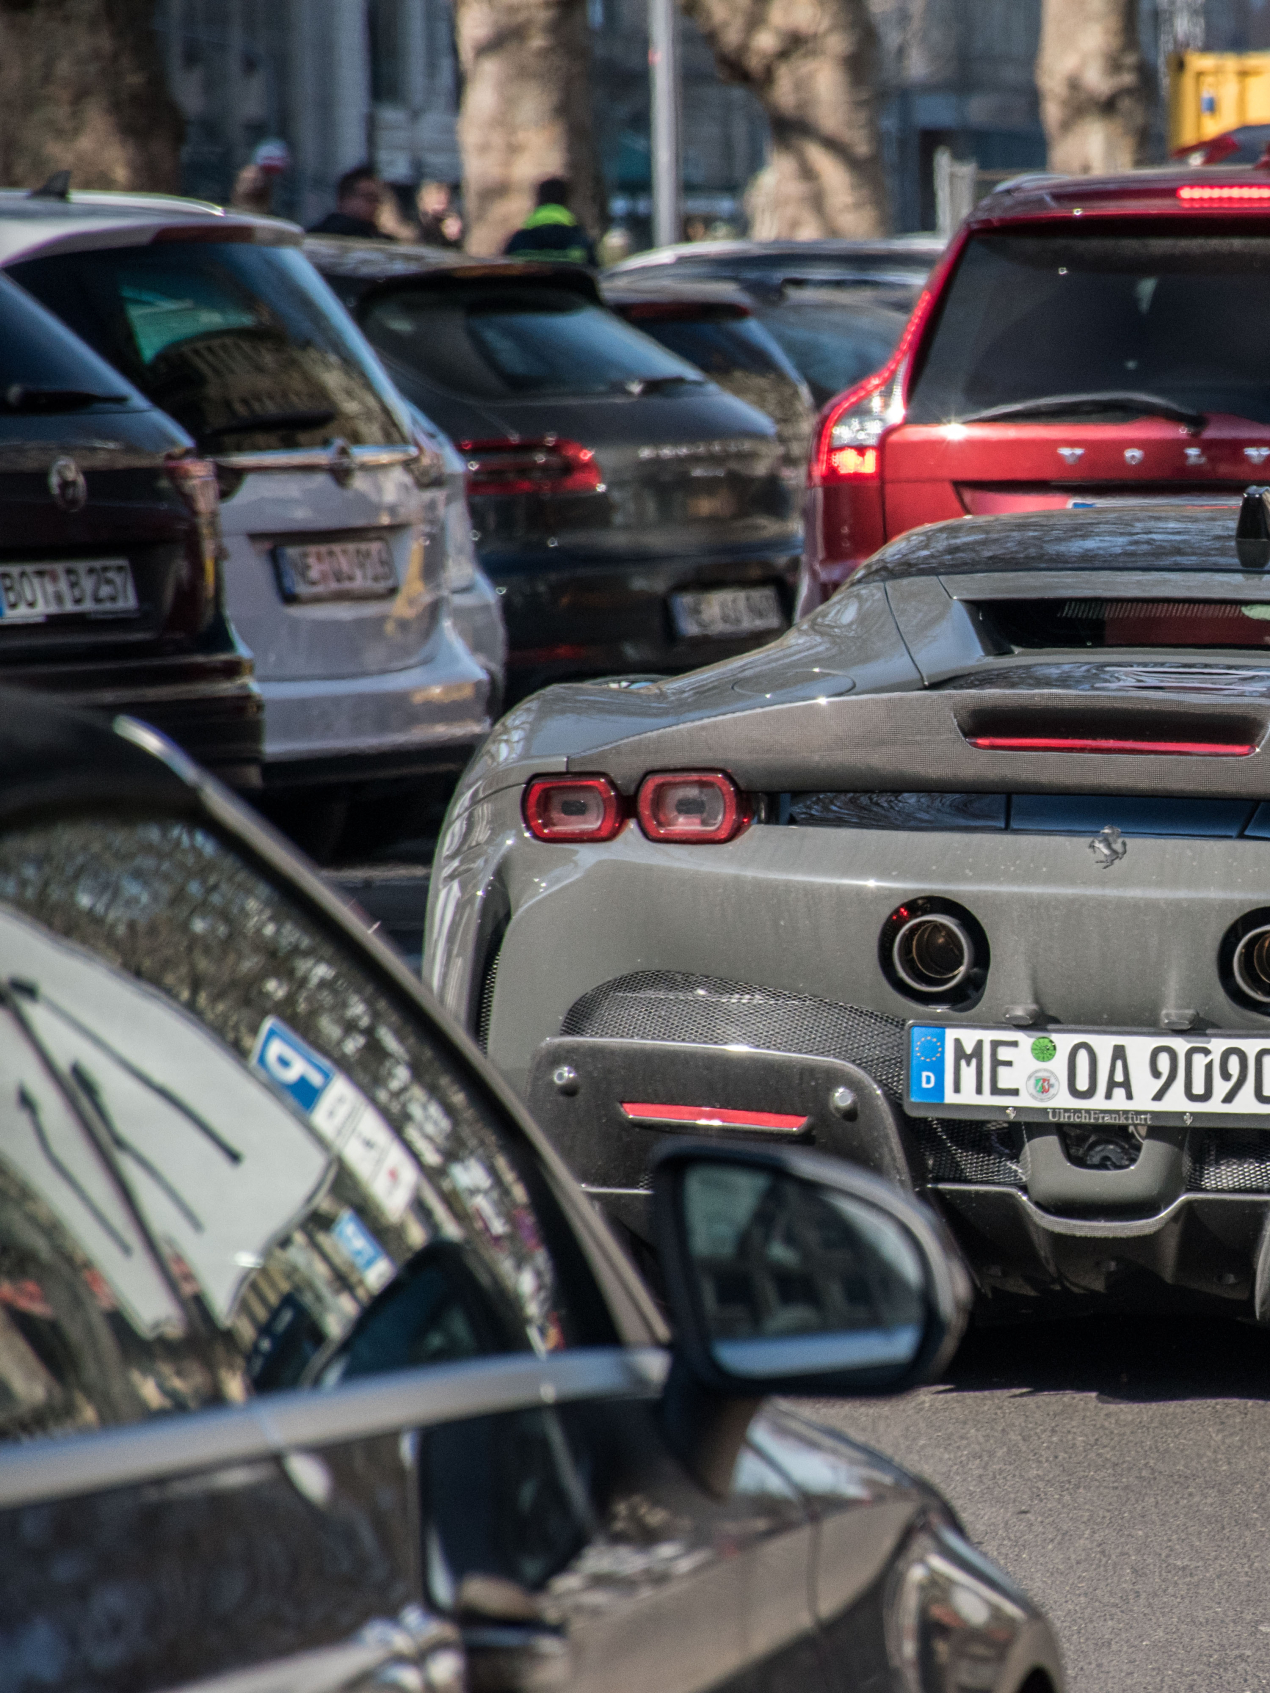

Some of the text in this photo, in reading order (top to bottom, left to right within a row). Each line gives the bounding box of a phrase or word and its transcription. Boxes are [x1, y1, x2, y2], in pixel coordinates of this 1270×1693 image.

[1, 564, 129, 609] BOT B 257
[921, 1071, 935, 1088] D
[952, 1037, 1020, 1097] ME
[1066, 1041, 1134, 1101] OA
[1047, 1108, 1153, 1125] UlrichFrankfurt
